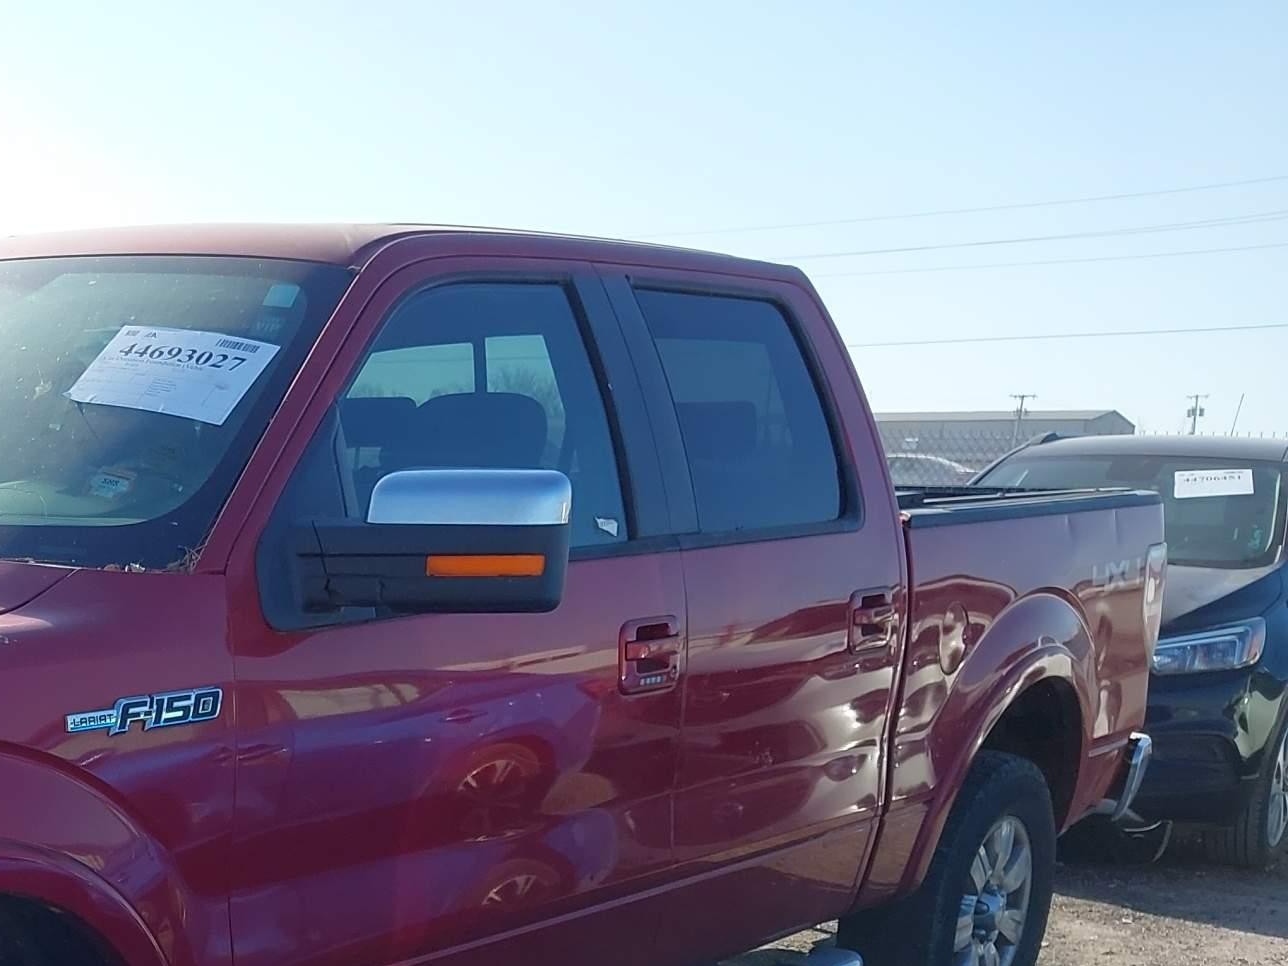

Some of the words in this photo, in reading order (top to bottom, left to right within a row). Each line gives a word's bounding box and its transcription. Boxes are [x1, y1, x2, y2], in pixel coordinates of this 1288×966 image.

[119, 342, 247, 372] 44693027
[71, 713, 114, 728] LARIAT
[115, 687, 223, 733] F-150
